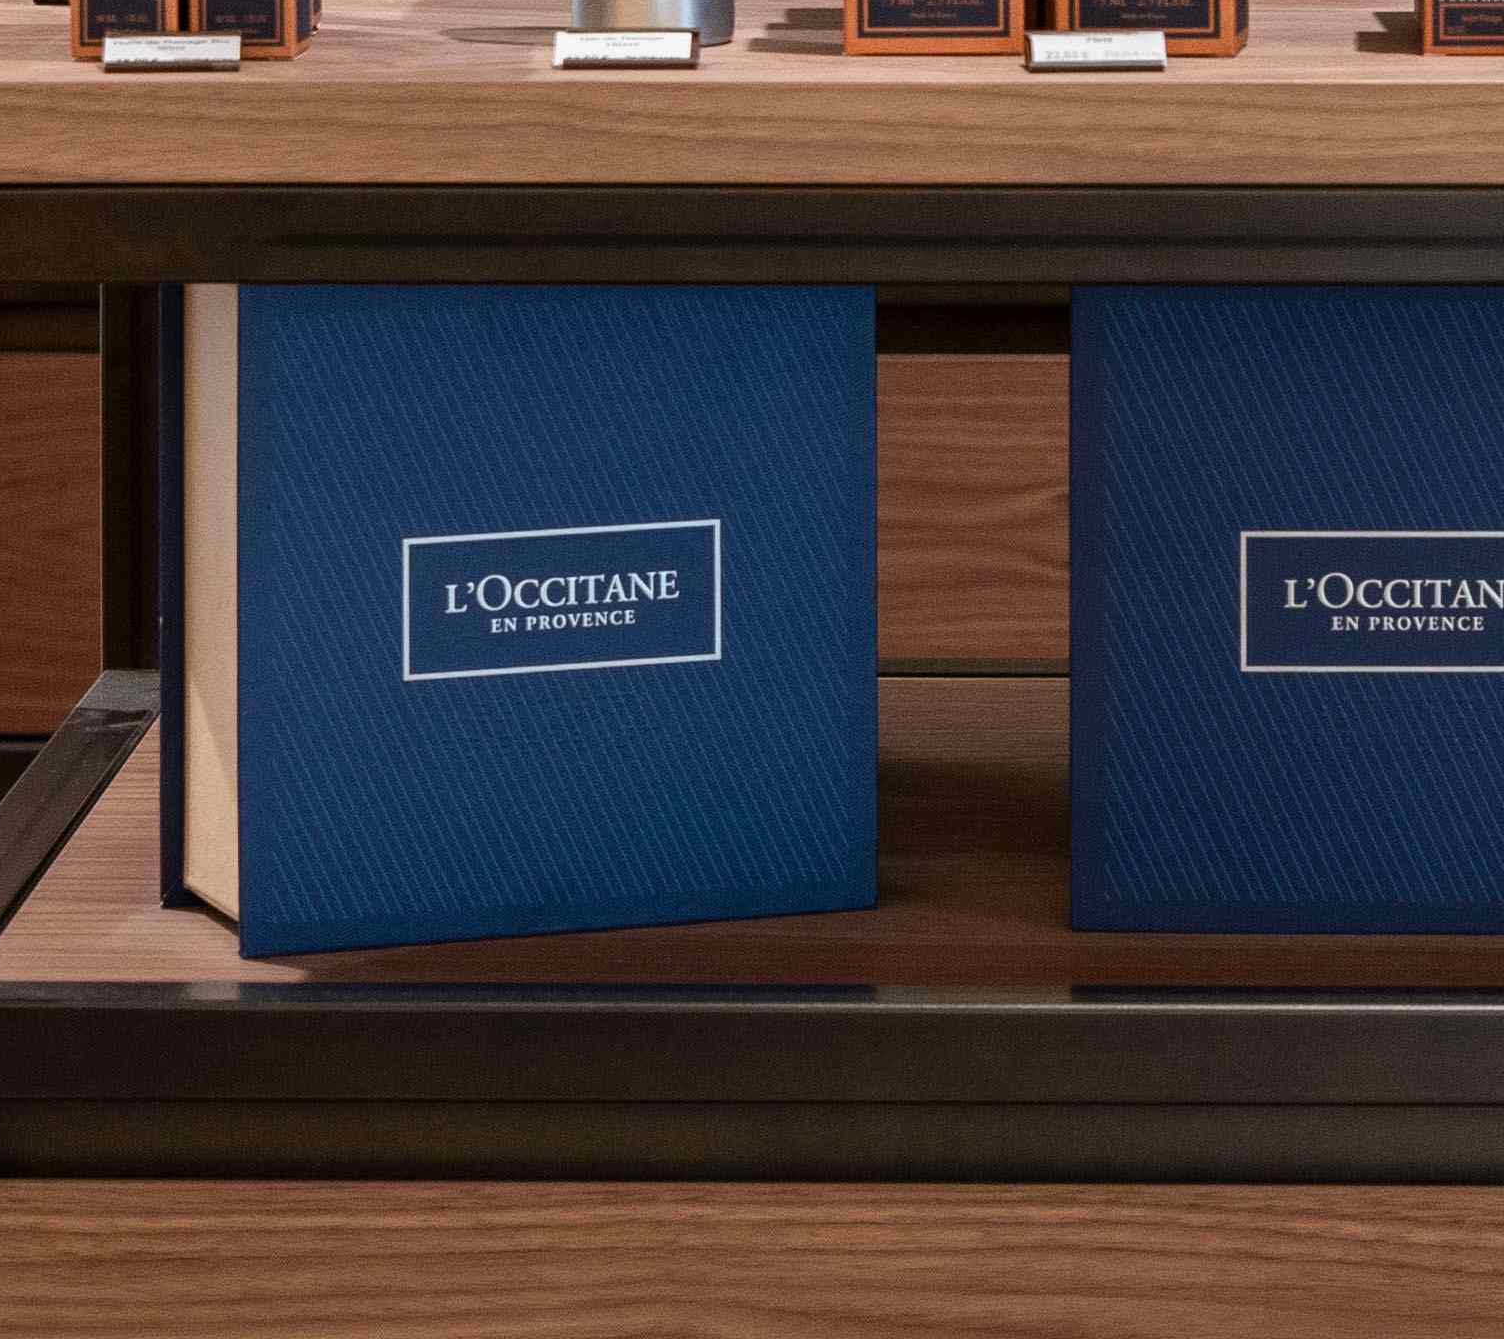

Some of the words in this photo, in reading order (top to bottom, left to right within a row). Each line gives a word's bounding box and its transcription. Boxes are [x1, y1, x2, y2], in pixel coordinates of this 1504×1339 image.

[445, 570, 680, 614] L'OCCITANE
[491, 618, 518, 633] EN
[526, 609, 636, 632] PROVENCE
[1331, 616, 1360, 631] EN
[1369, 616, 1485, 631] PROVENCE
